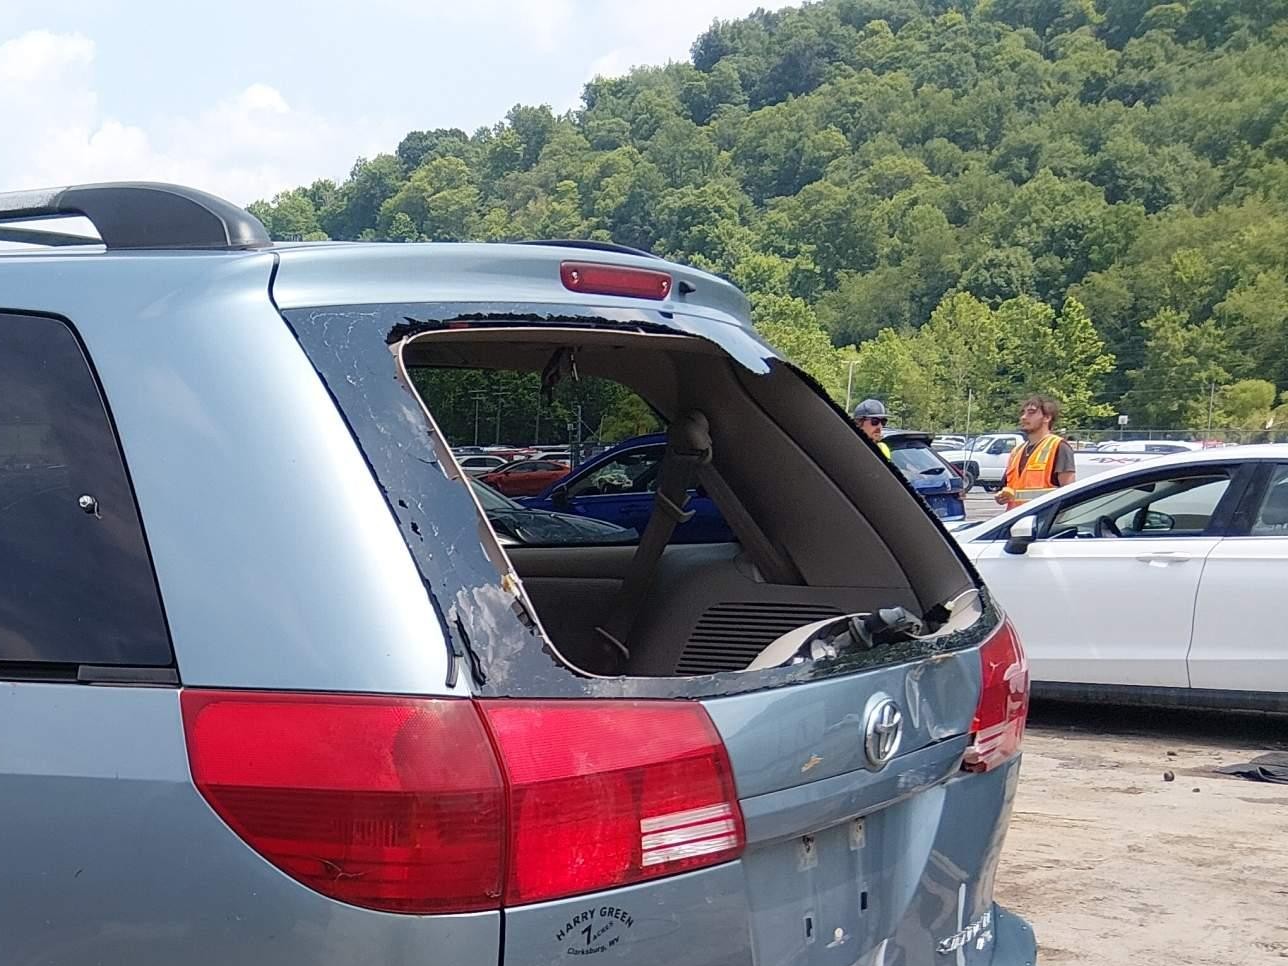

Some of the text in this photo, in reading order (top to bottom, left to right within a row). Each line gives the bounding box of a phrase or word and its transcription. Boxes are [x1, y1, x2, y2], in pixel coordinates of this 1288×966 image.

[556, 906, 634, 941] HARRY GREEN
[581, 924, 592, 945] 7
